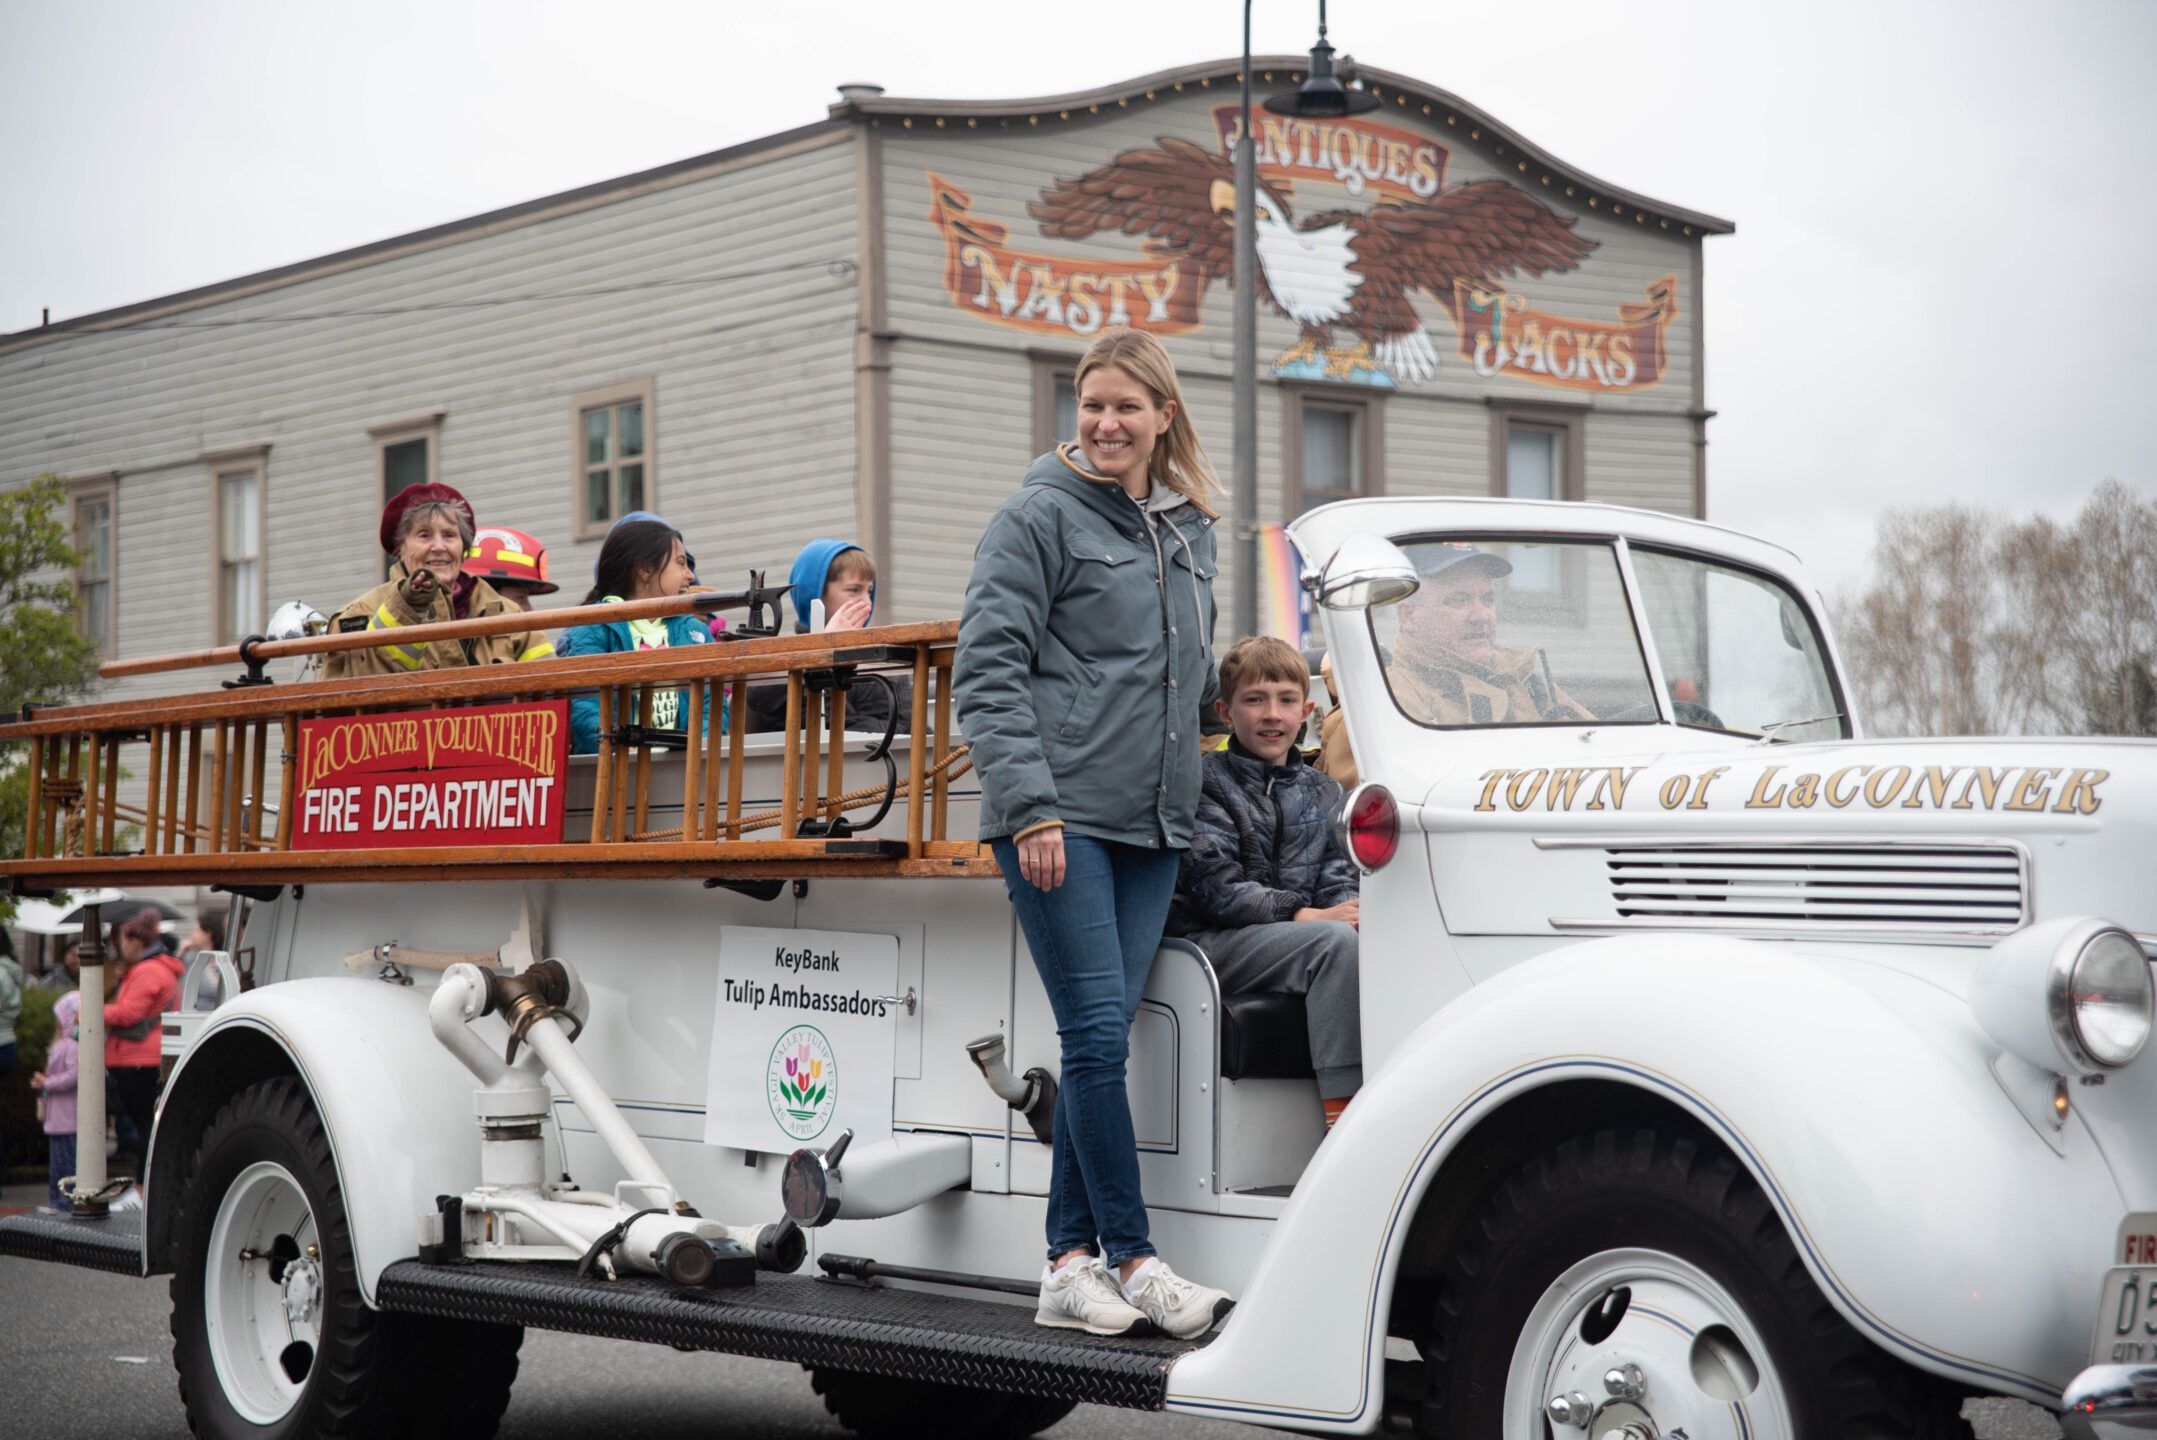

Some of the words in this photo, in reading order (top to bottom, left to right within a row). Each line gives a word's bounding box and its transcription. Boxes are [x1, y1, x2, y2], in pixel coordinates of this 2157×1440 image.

[960, 244, 1180, 335] NASTY
[1468, 287, 1638, 387] JACKS
[299, 718, 418, 797] LaCONNER
[423, 710, 557, 776] VOLUNTEER
[303, 786, 361, 833] FIRE
[372, 777, 554, 831] DEPARTMENT
[1473, 766, 1648, 812] TOWN
[1658, 766, 1731, 810] of
[1745, 765, 2110, 816] LaCONNER
[775, 947, 840, 973] KeyBank
[724, 979, 765, 1010] Tulip
[769, 983, 887, 1017] Ambassadors
[773, 1032, 804, 1065] VALLEY
[807, 1032, 830, 1060] TULIP
[788, 1122, 815, 1136] APRIL
